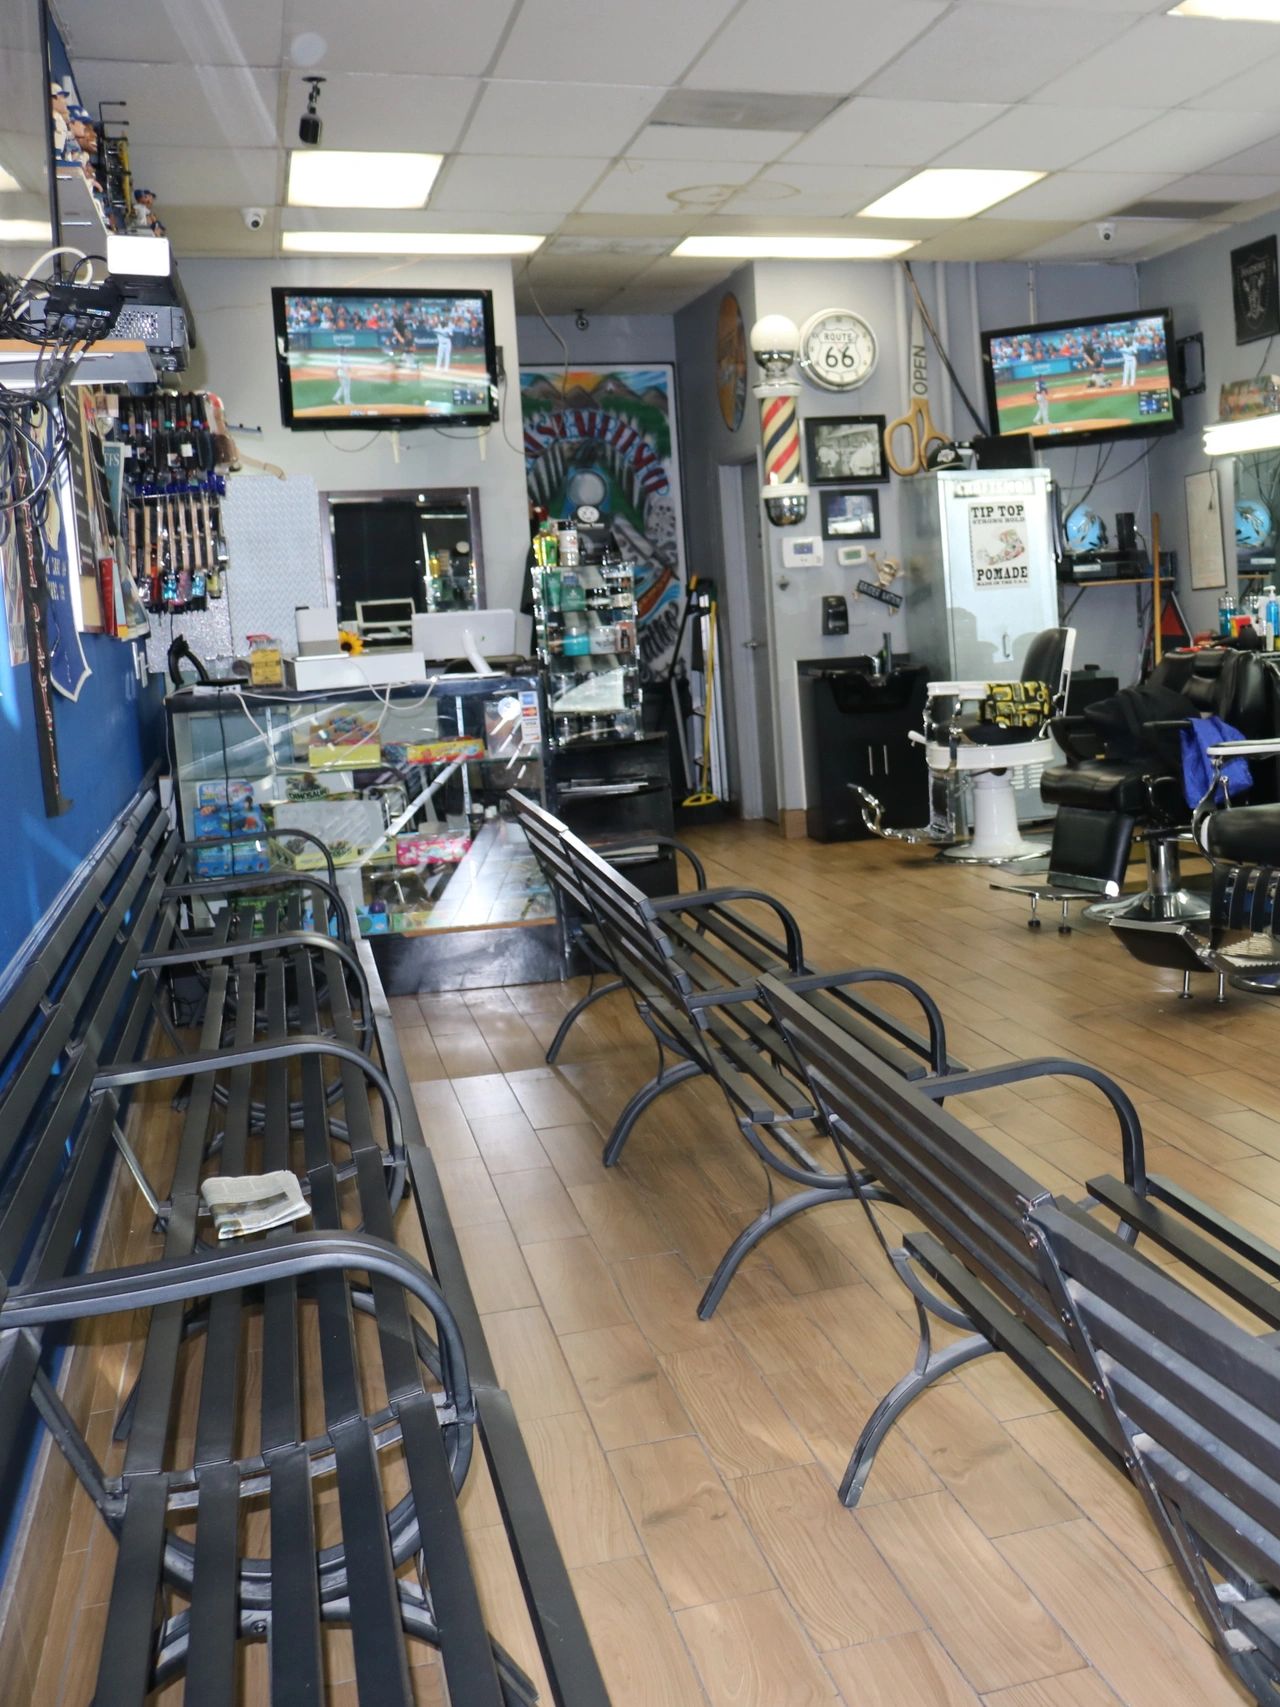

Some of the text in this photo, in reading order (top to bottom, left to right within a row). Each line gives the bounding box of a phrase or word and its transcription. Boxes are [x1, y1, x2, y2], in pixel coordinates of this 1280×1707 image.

[824, 332, 853, 343] ROUTE
[825, 346, 855, 368] 66
[912, 345, 928, 395] OPEN
[971, 505, 1024, 518] TIP TOP
[976, 566, 1028, 581] POMADE
